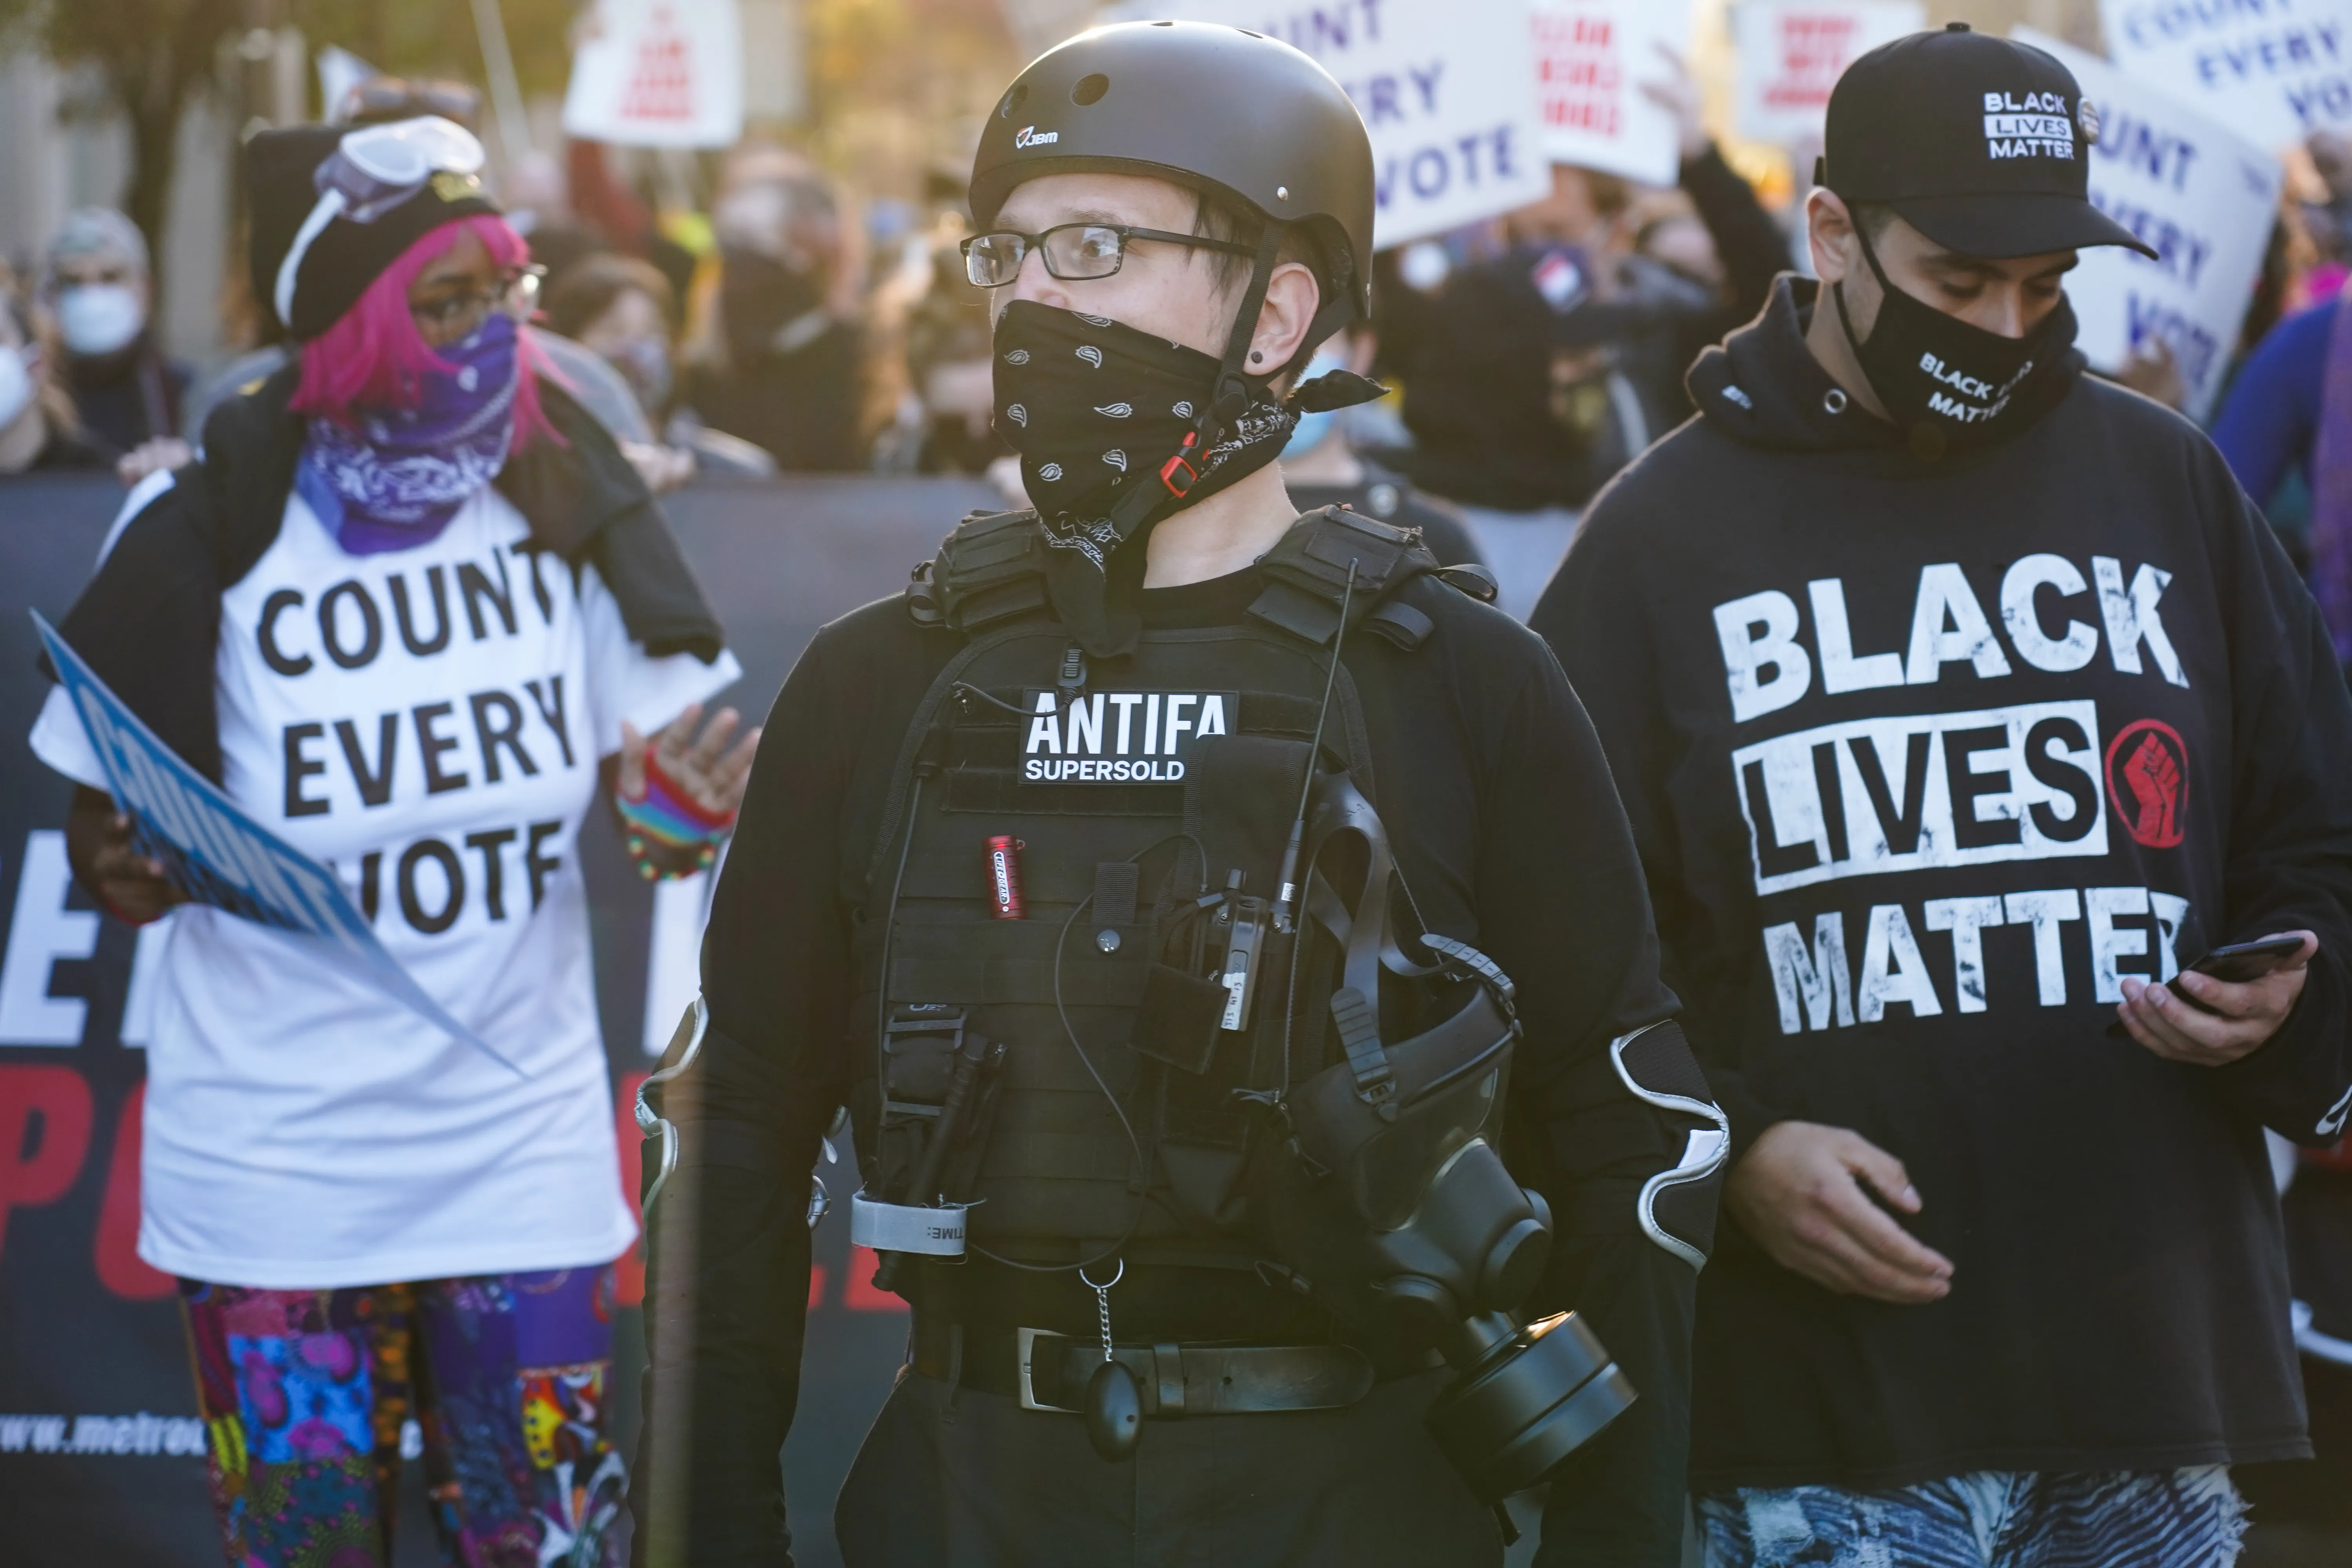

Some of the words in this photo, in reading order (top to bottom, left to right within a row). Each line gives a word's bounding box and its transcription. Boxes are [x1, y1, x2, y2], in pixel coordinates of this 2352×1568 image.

[1984, 91, 2067, 115] BLACK
[1996, 119, 2067, 136] LIVES
[1989, 138, 2075, 160] MATTER
[1919, 352, 1994, 400] BLACK
[1712, 553, 2190, 722] BLACK
[1025, 692, 1226, 755] ANTIFA
[283, 675, 575, 818] EVERY
[1025, 759, 1185, 780] SUPERSOLD
[1741, 716, 2101, 880] LIVES
[927, 1227, 964, 1240] TIME:
